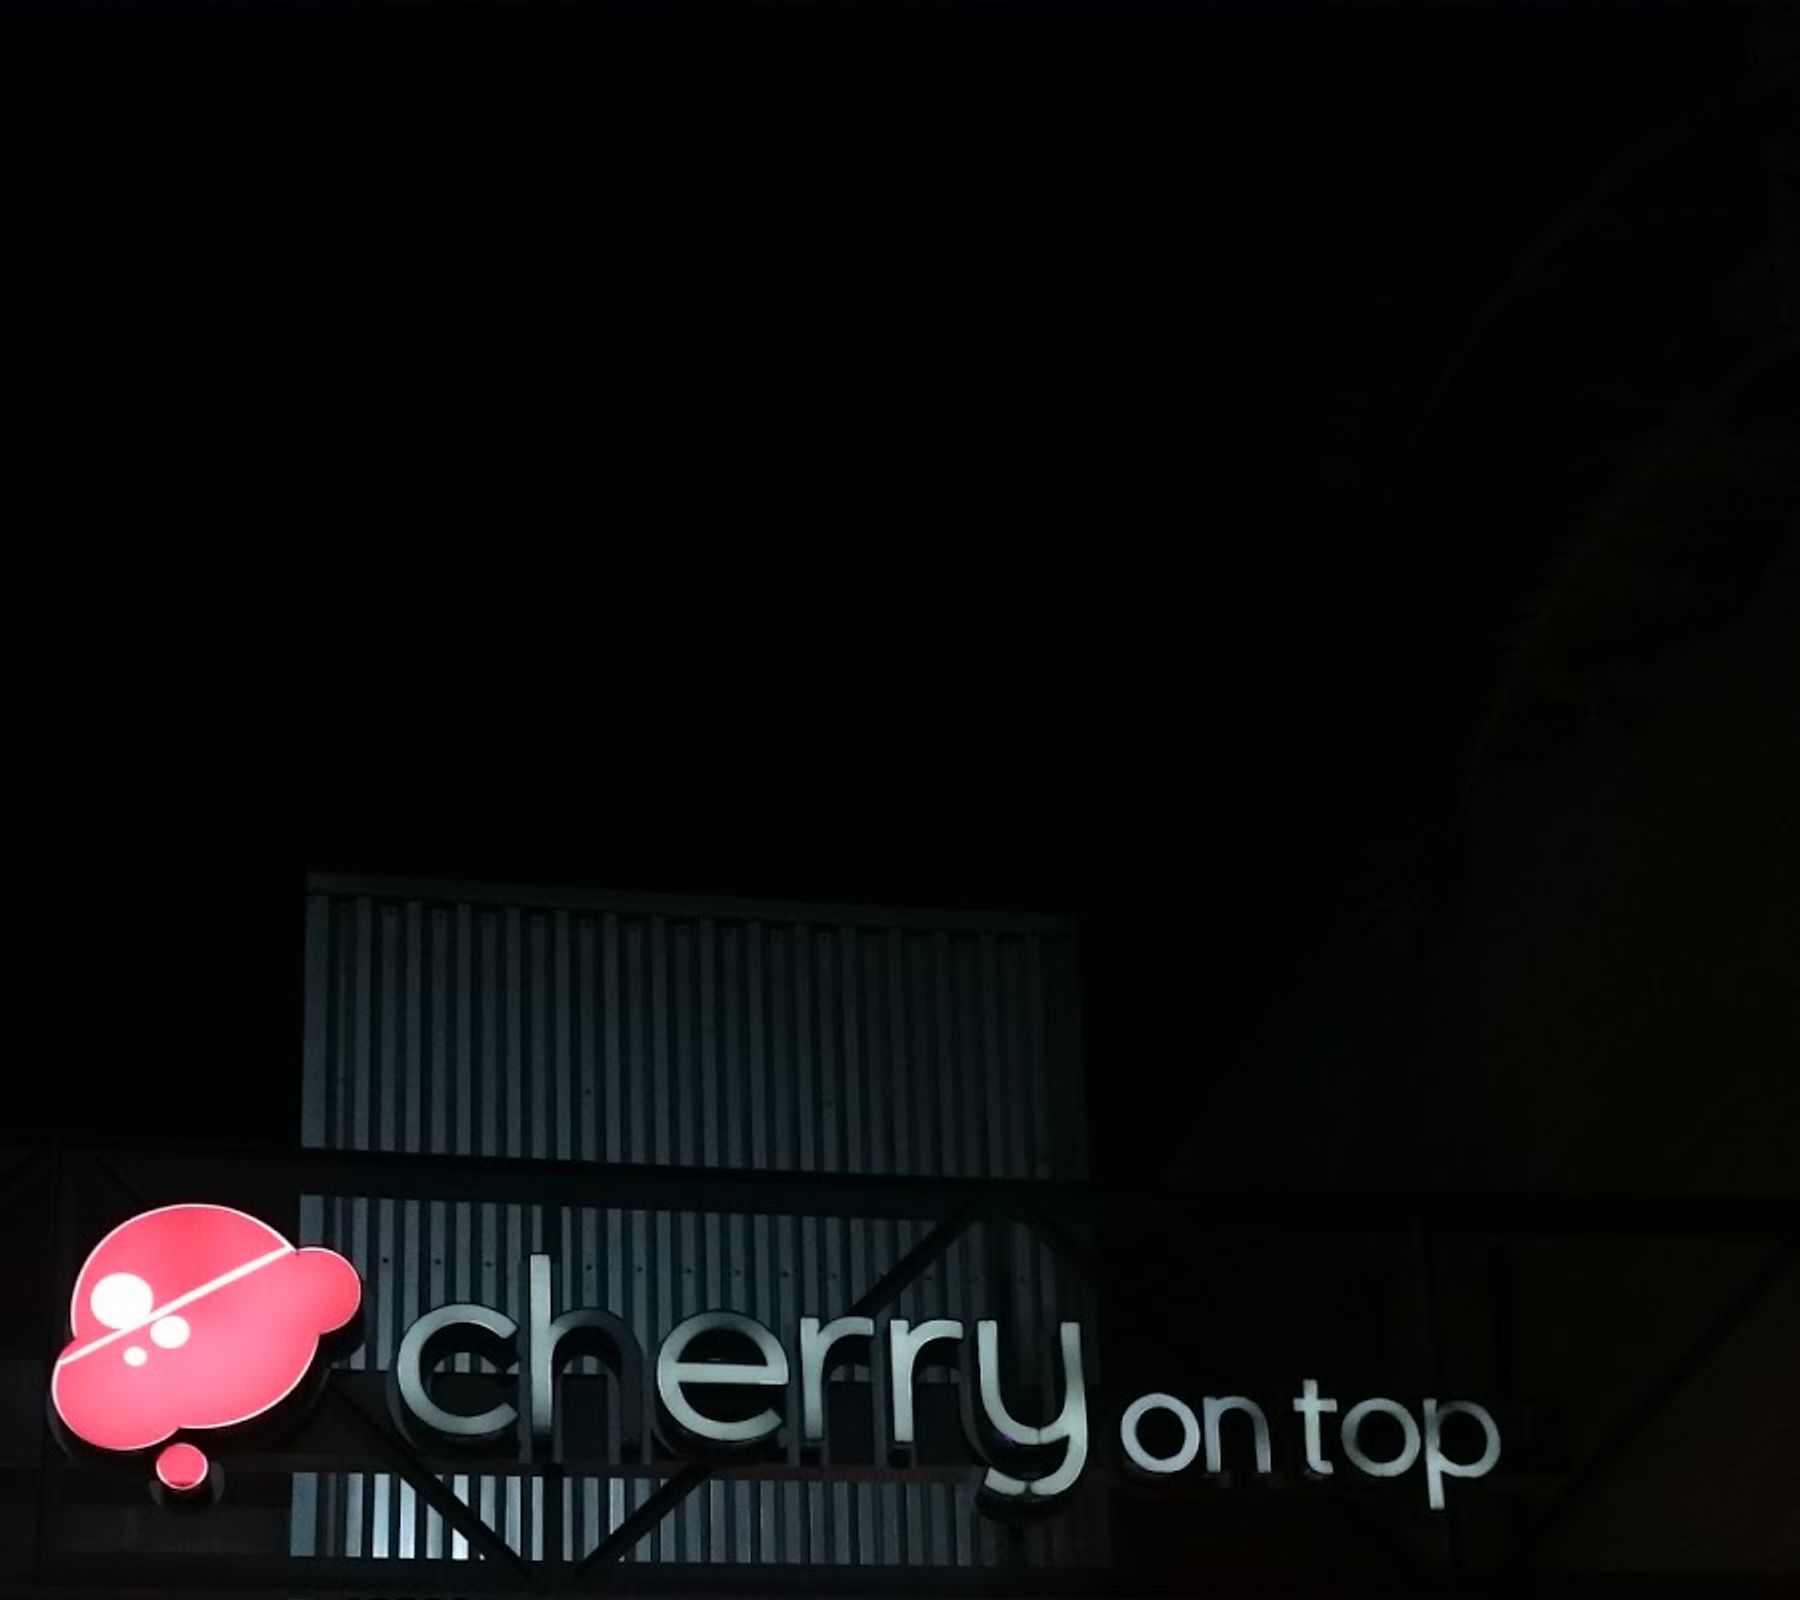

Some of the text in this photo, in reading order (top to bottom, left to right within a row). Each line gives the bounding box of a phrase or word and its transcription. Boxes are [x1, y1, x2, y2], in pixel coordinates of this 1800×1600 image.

[398, 1254, 1500, 1509] cherry on top
